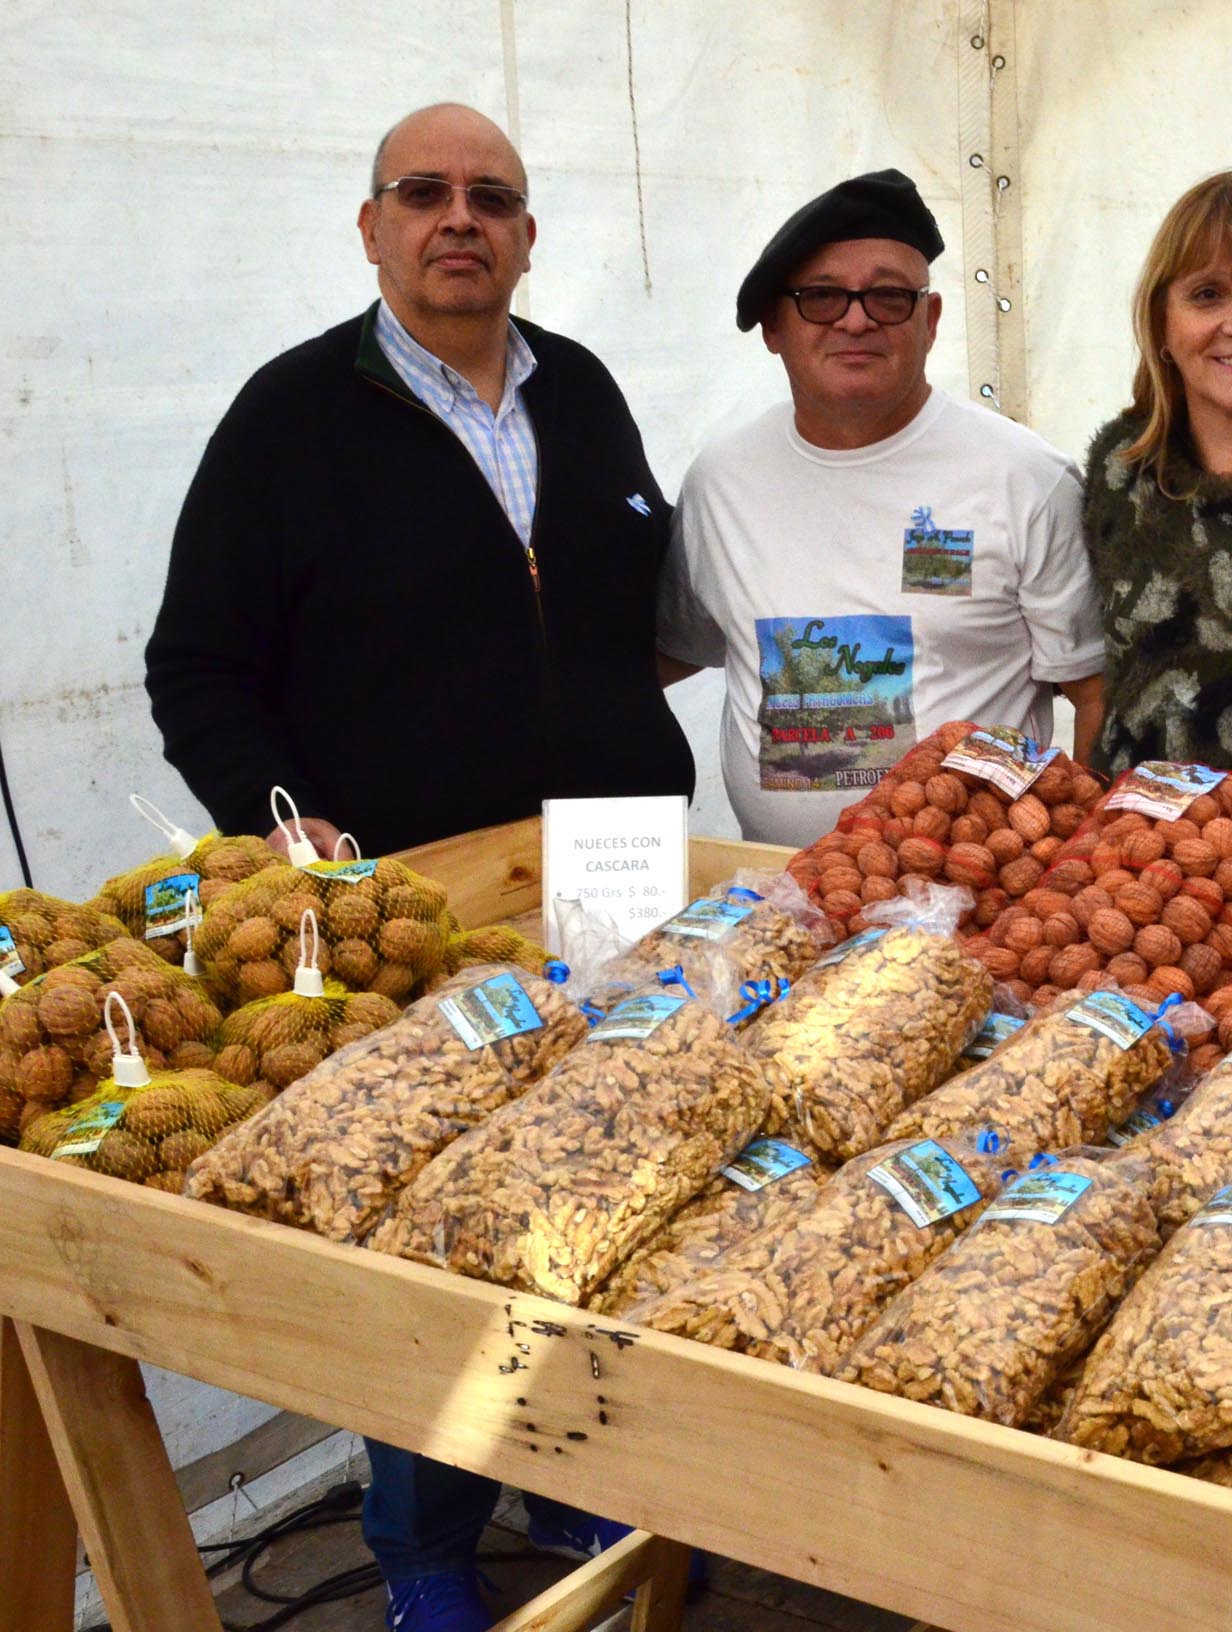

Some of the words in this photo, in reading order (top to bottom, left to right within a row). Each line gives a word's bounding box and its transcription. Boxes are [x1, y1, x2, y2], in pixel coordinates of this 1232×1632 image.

[792, 619, 838, 650] Los
[823, 643, 906, 683] Nogales
[771, 727, 832, 744] PARCELA
[870, 724, 895, 741] 206
[574, 837, 628, 850] NUECES
[631, 836, 662, 849] CON
[585, 859, 650, 873] CASCARA
[576, 887, 598, 899] 750
[601, 887, 623, 899] Grs
[628, 886, 636, 898] $
